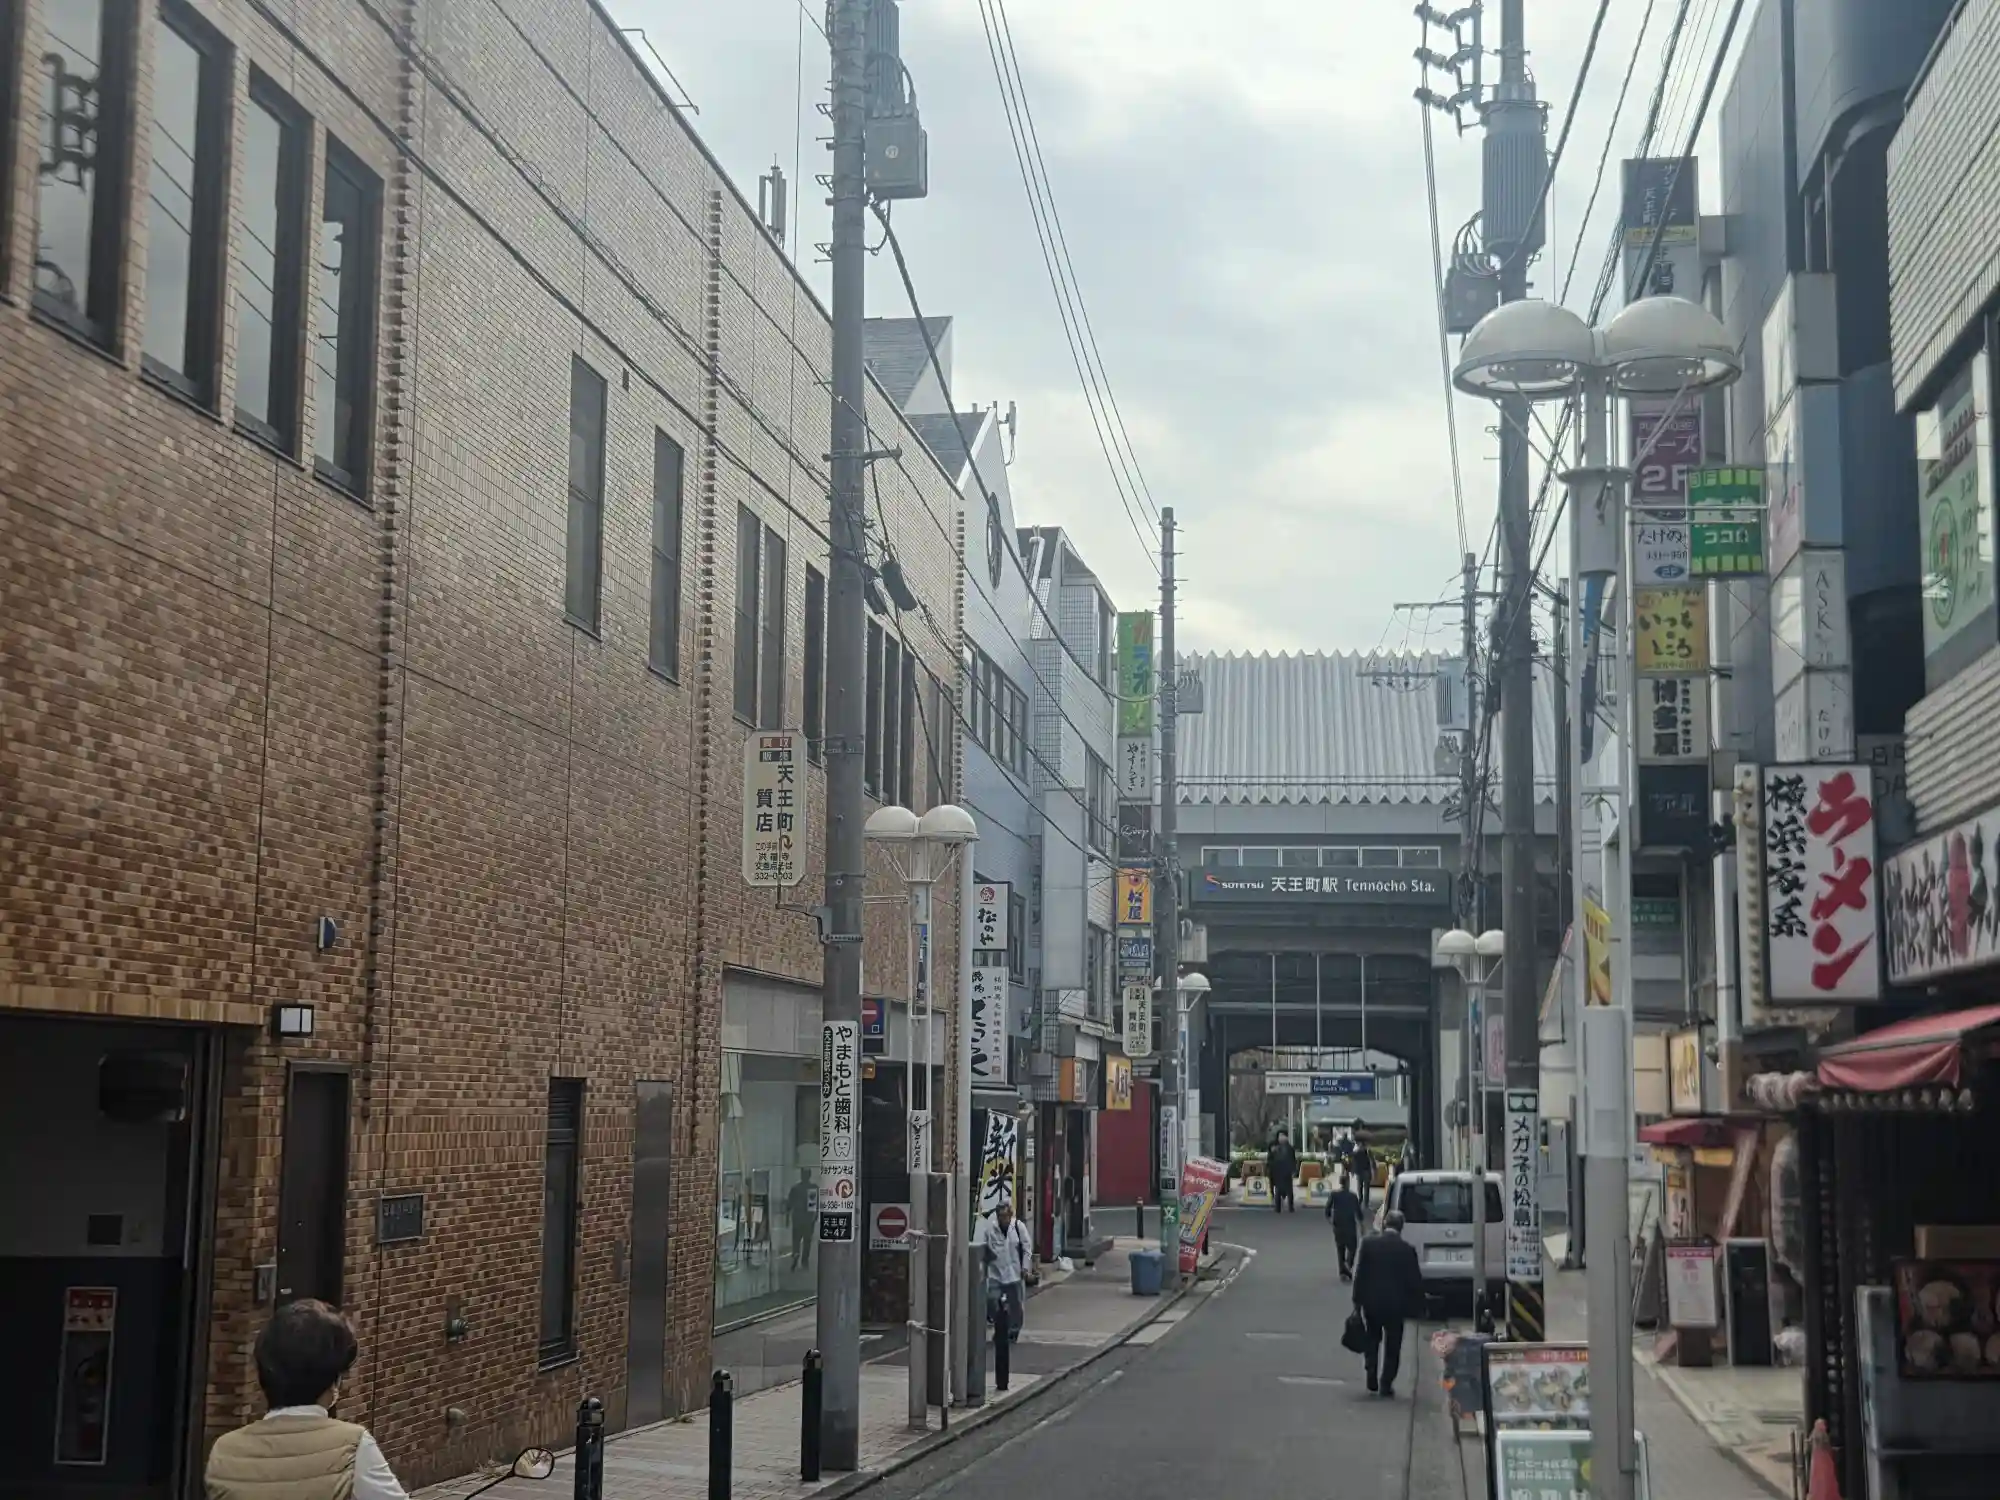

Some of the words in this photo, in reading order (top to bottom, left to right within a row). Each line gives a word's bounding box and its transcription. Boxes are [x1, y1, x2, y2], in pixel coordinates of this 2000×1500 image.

[1637, 527, 1688, 546] たけの
[756, 788, 773, 832] 質店
[777, 764, 794, 832] 天王町
[754, 872, 793, 881] 332-003
[1271, 876, 1338, 893] 天王町駅
[1411, 879, 1436, 893] Sta.
[1805, 771, 1875, 991] ラーメン
[835, 1026, 852, 1133] やまもと歯科
[821, 1101, 831, 1157] クリニック
[823, 1217, 846, 1227] 天王町
[823, 1229, 846, 1237] 2-47
